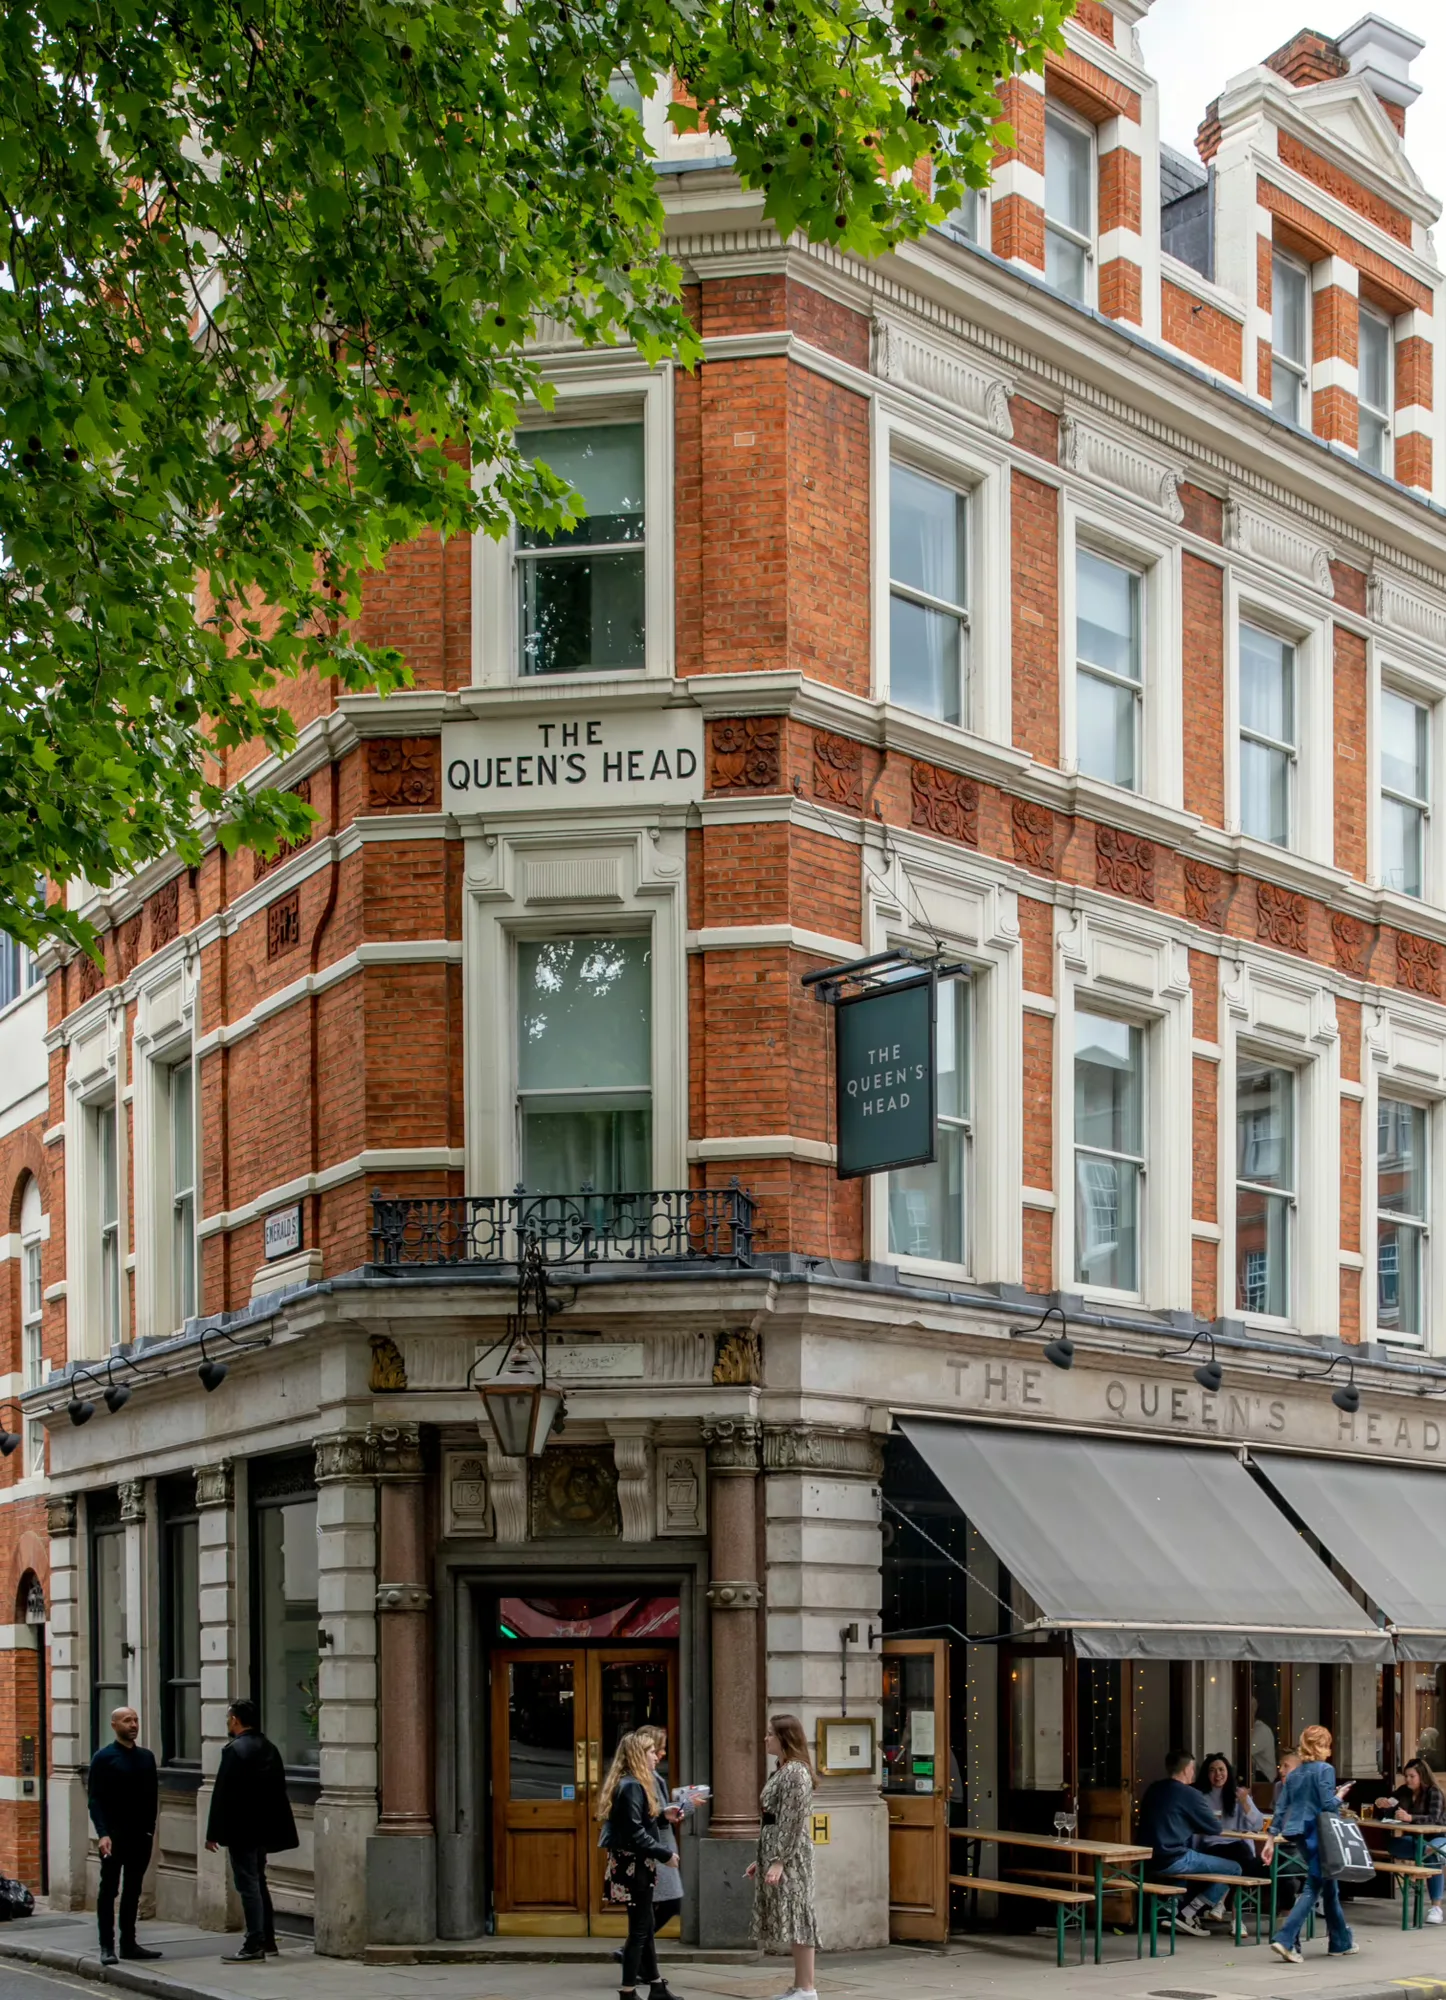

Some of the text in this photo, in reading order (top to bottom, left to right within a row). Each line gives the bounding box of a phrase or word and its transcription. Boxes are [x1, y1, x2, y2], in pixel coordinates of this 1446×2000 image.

[538, 721, 603, 748] THE
[448, 748, 697, 792] QUEEN'S HEAD
[868, 1044, 901, 1065] THE
[847, 1064, 924, 1097] QUEEN'S
[863, 1093, 910, 1117] HEAD
[266, 1218, 291, 1245] EMERALD
[946, 1359, 1441, 1451] THE QUEEN'S HEAD
